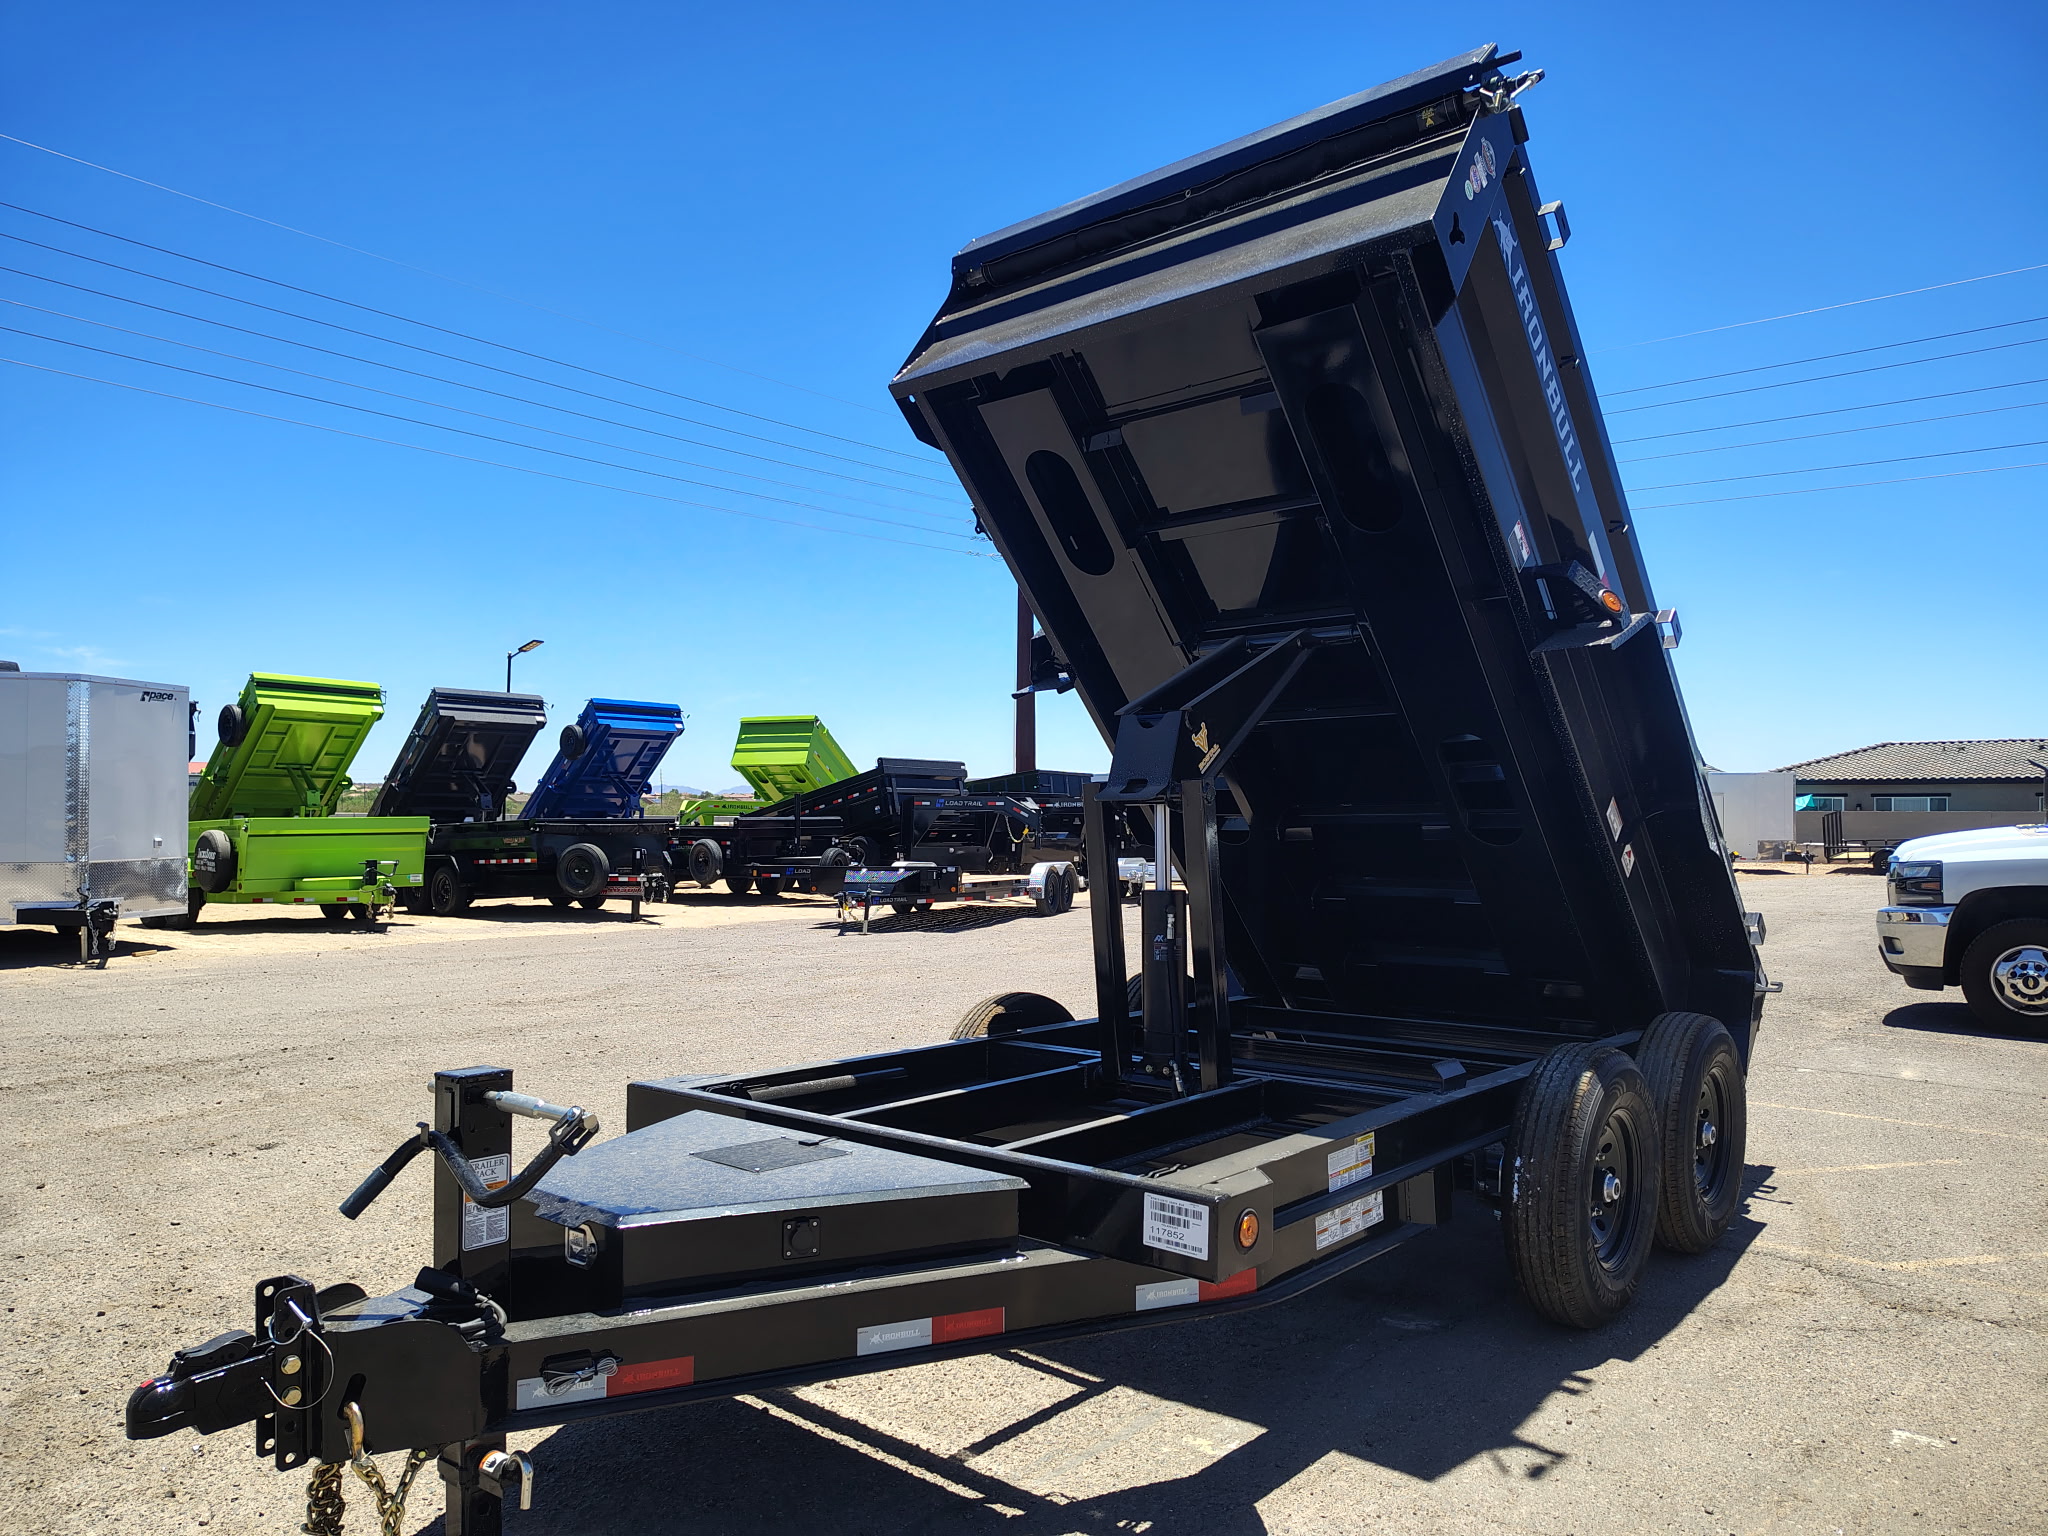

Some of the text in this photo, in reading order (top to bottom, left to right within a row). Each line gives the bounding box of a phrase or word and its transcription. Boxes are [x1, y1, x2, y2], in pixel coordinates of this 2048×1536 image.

[1511, 263, 1583, 494] IRONBULL
[1150, 1225, 1185, 1241] 117852
[1156, 1287, 1189, 1299] IRONBULL
[881, 1327, 921, 1341] IRONBULL
